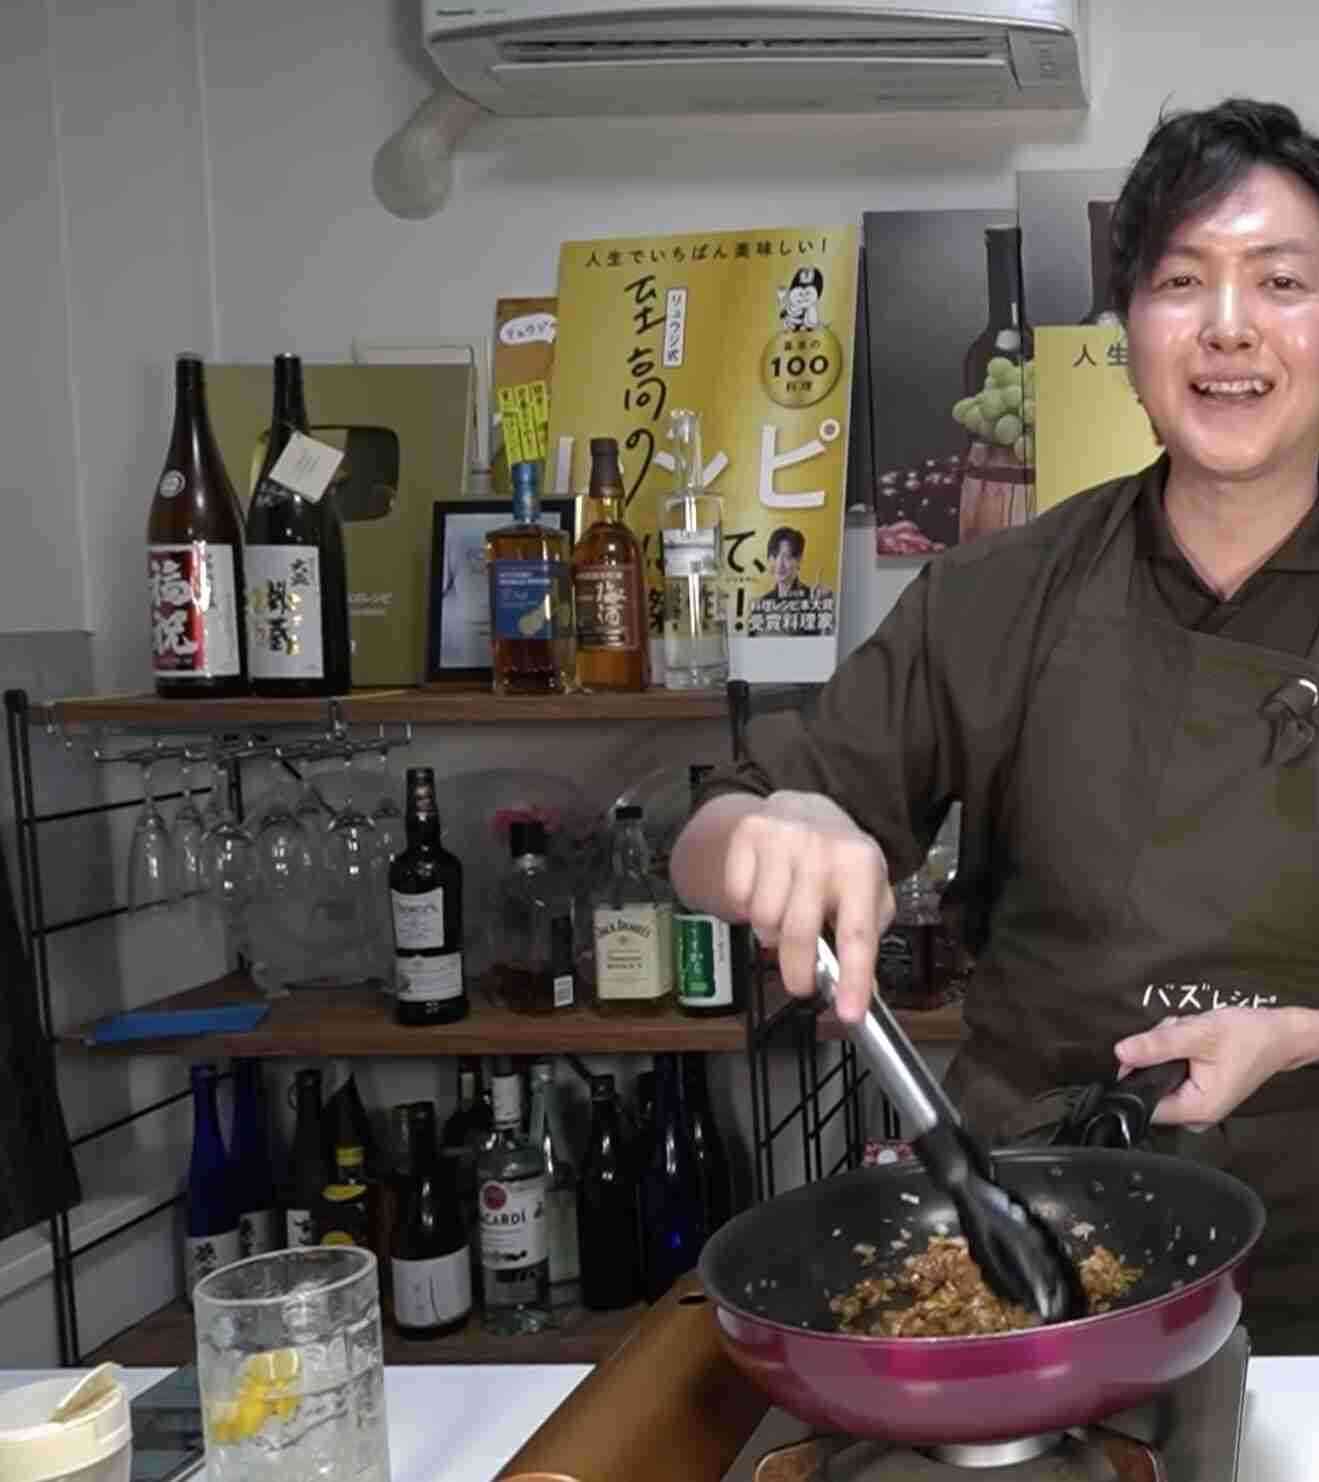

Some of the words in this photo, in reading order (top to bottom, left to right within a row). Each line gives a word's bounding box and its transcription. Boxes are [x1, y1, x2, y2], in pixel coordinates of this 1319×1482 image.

[585, 238, 828, 267] 人生でいちばん美味しい!
[770, 354, 829, 378] 100
